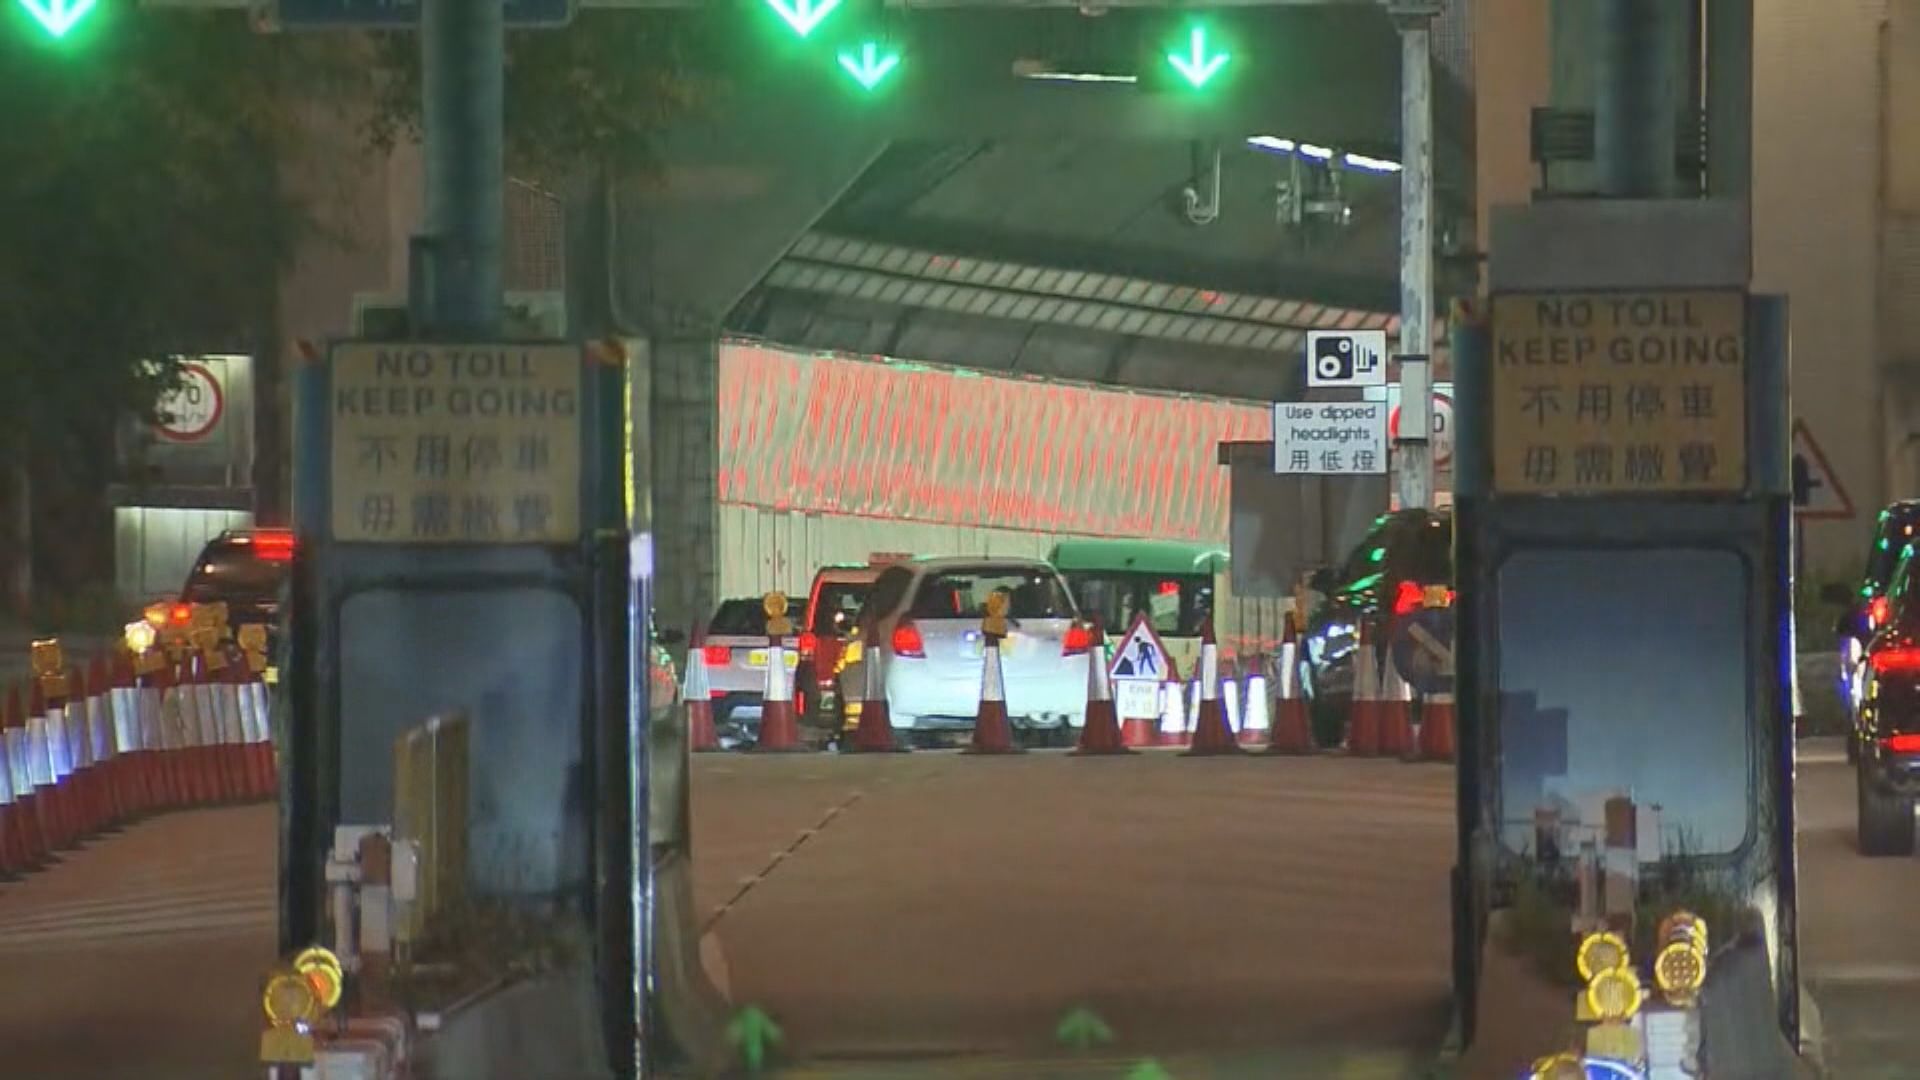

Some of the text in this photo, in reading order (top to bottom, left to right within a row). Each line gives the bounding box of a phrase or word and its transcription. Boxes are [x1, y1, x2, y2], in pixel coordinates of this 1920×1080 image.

[1536, 297, 1703, 328] NO TOLL
[376, 350, 535, 378] NO TOLL
[1498, 336, 1739, 365] KEEP GOING
[337, 387, 575, 415] KEEP GOING
[1285, 406, 1376, 424] Use dipped
[1520, 382, 1718, 428] 不用停車
[1291, 426, 1370, 443] headlights
[357, 433, 550, 476] 不用停車
[1289, 450, 1376, 471] 用低燈
